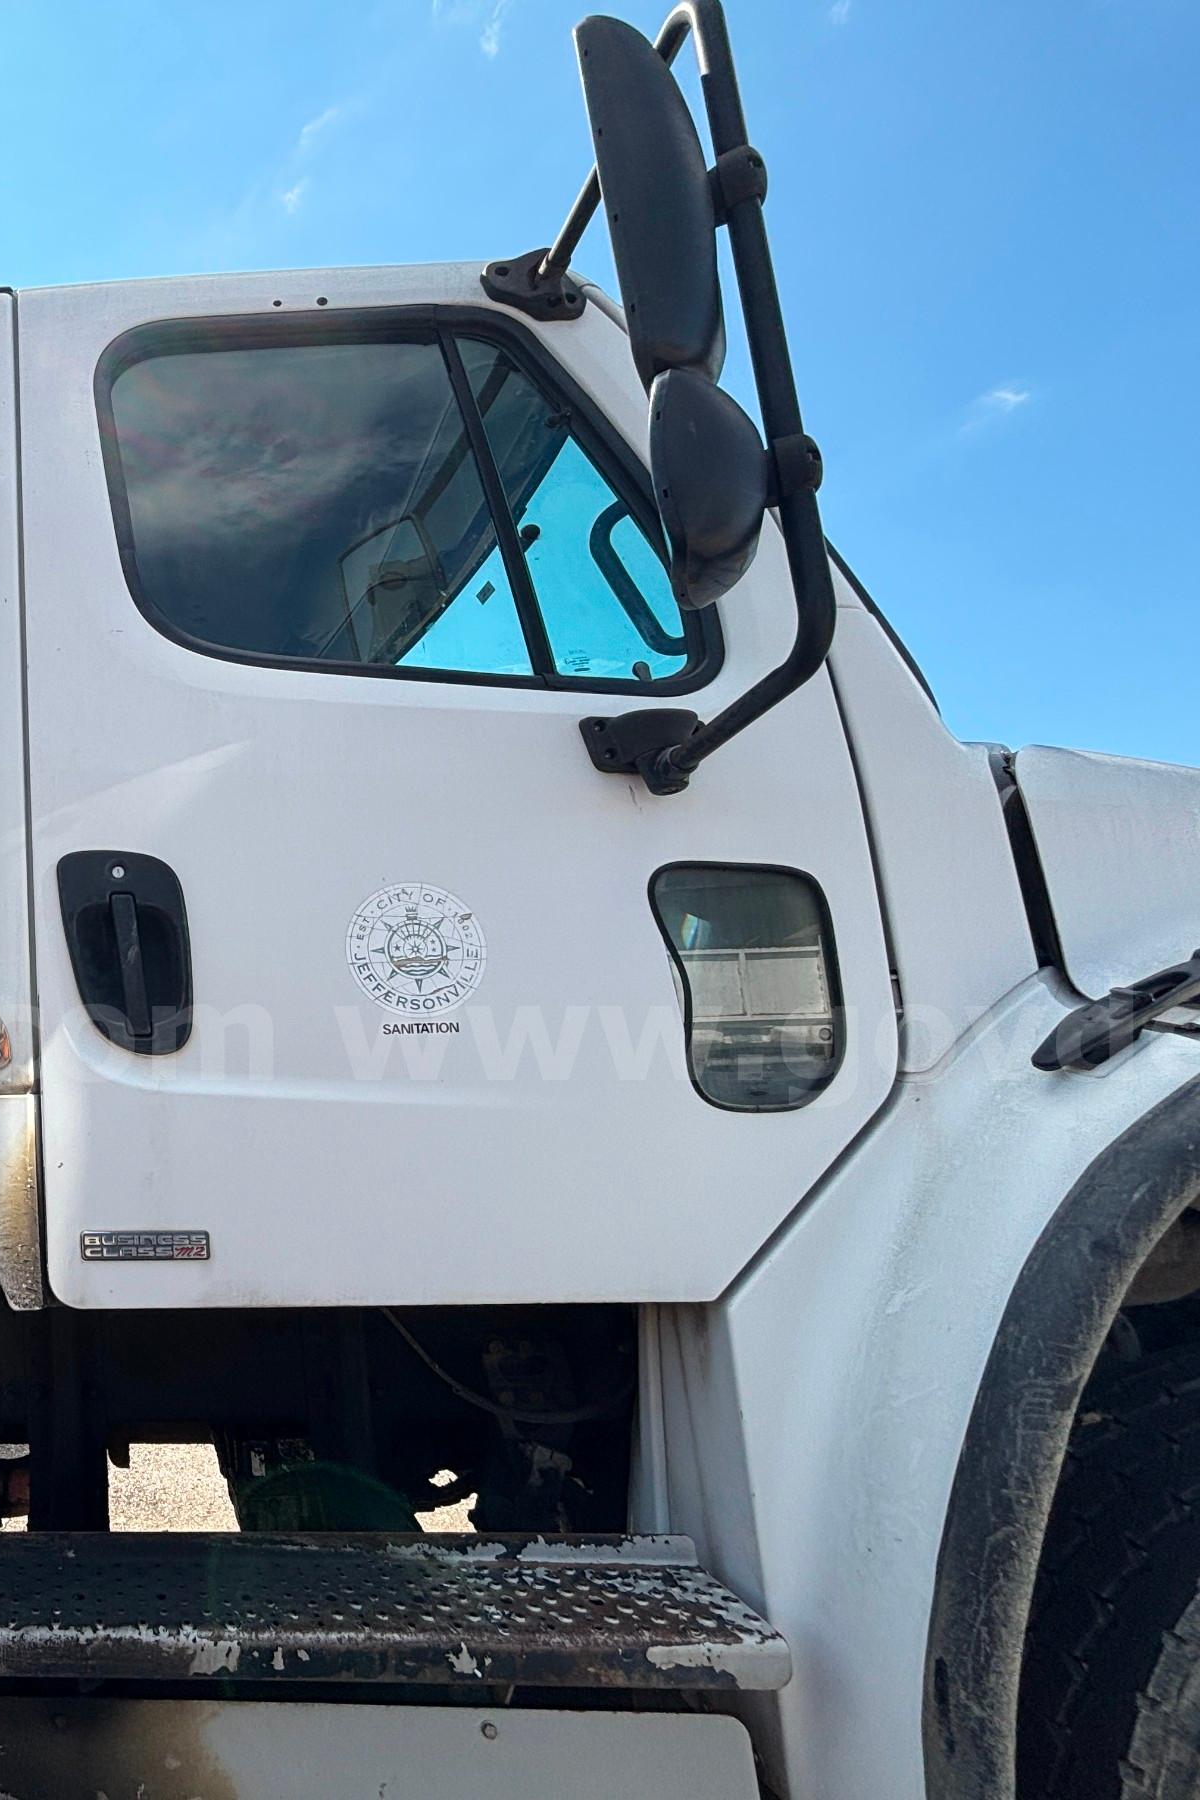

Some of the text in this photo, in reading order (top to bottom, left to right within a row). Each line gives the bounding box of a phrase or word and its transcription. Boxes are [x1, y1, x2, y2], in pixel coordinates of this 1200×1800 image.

[377, 889, 447, 910] CITY OF
[356, 917, 371, 941] EST
[354, 948, 479, 1011] JEFFERSONVILLE
[382, 1021, 460, 1036] SANITATION
[84, 1235, 206, 1246] BUSINESS
[84, 1247, 173, 1257] CLASS
